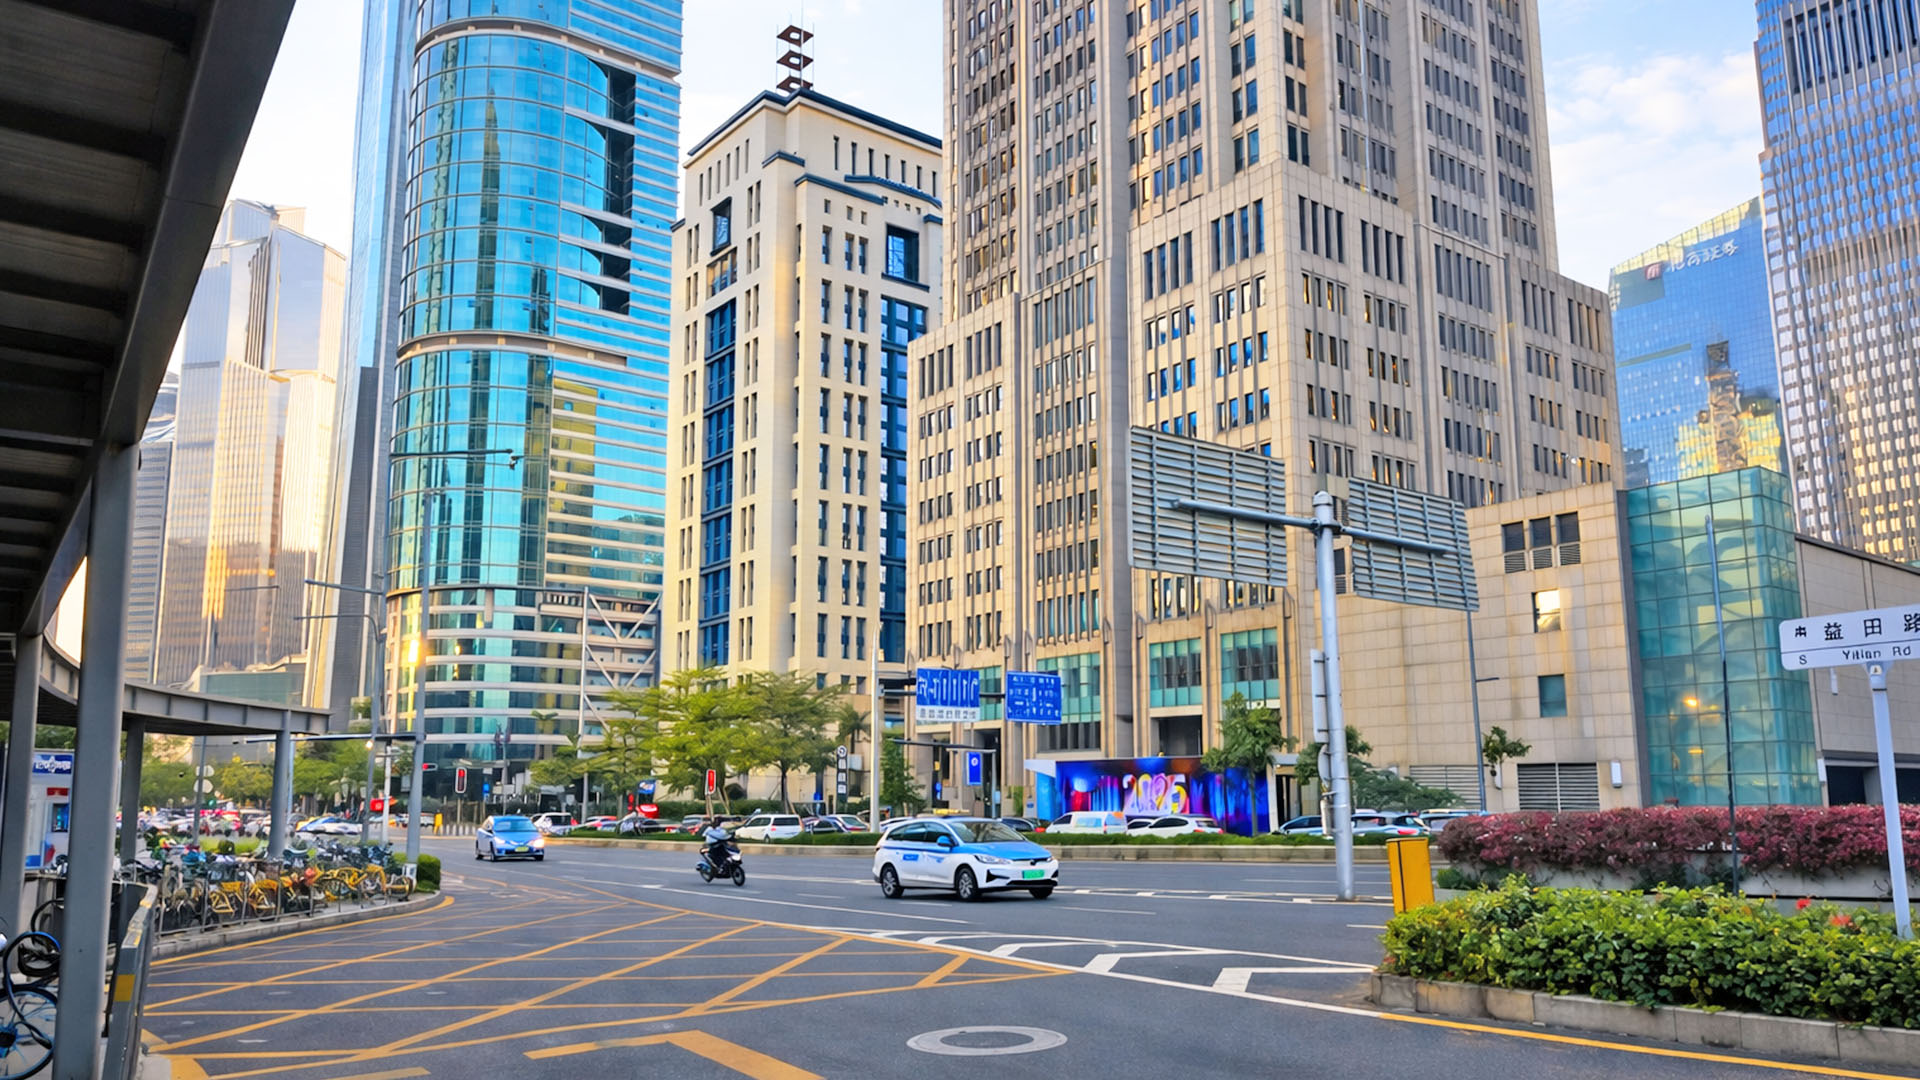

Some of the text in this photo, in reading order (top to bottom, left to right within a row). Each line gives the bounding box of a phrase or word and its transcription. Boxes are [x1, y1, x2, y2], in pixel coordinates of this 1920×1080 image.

[1824, 612, 1920, 641] 益田路
[1799, 646, 1912, 665] S Yitian Rd
